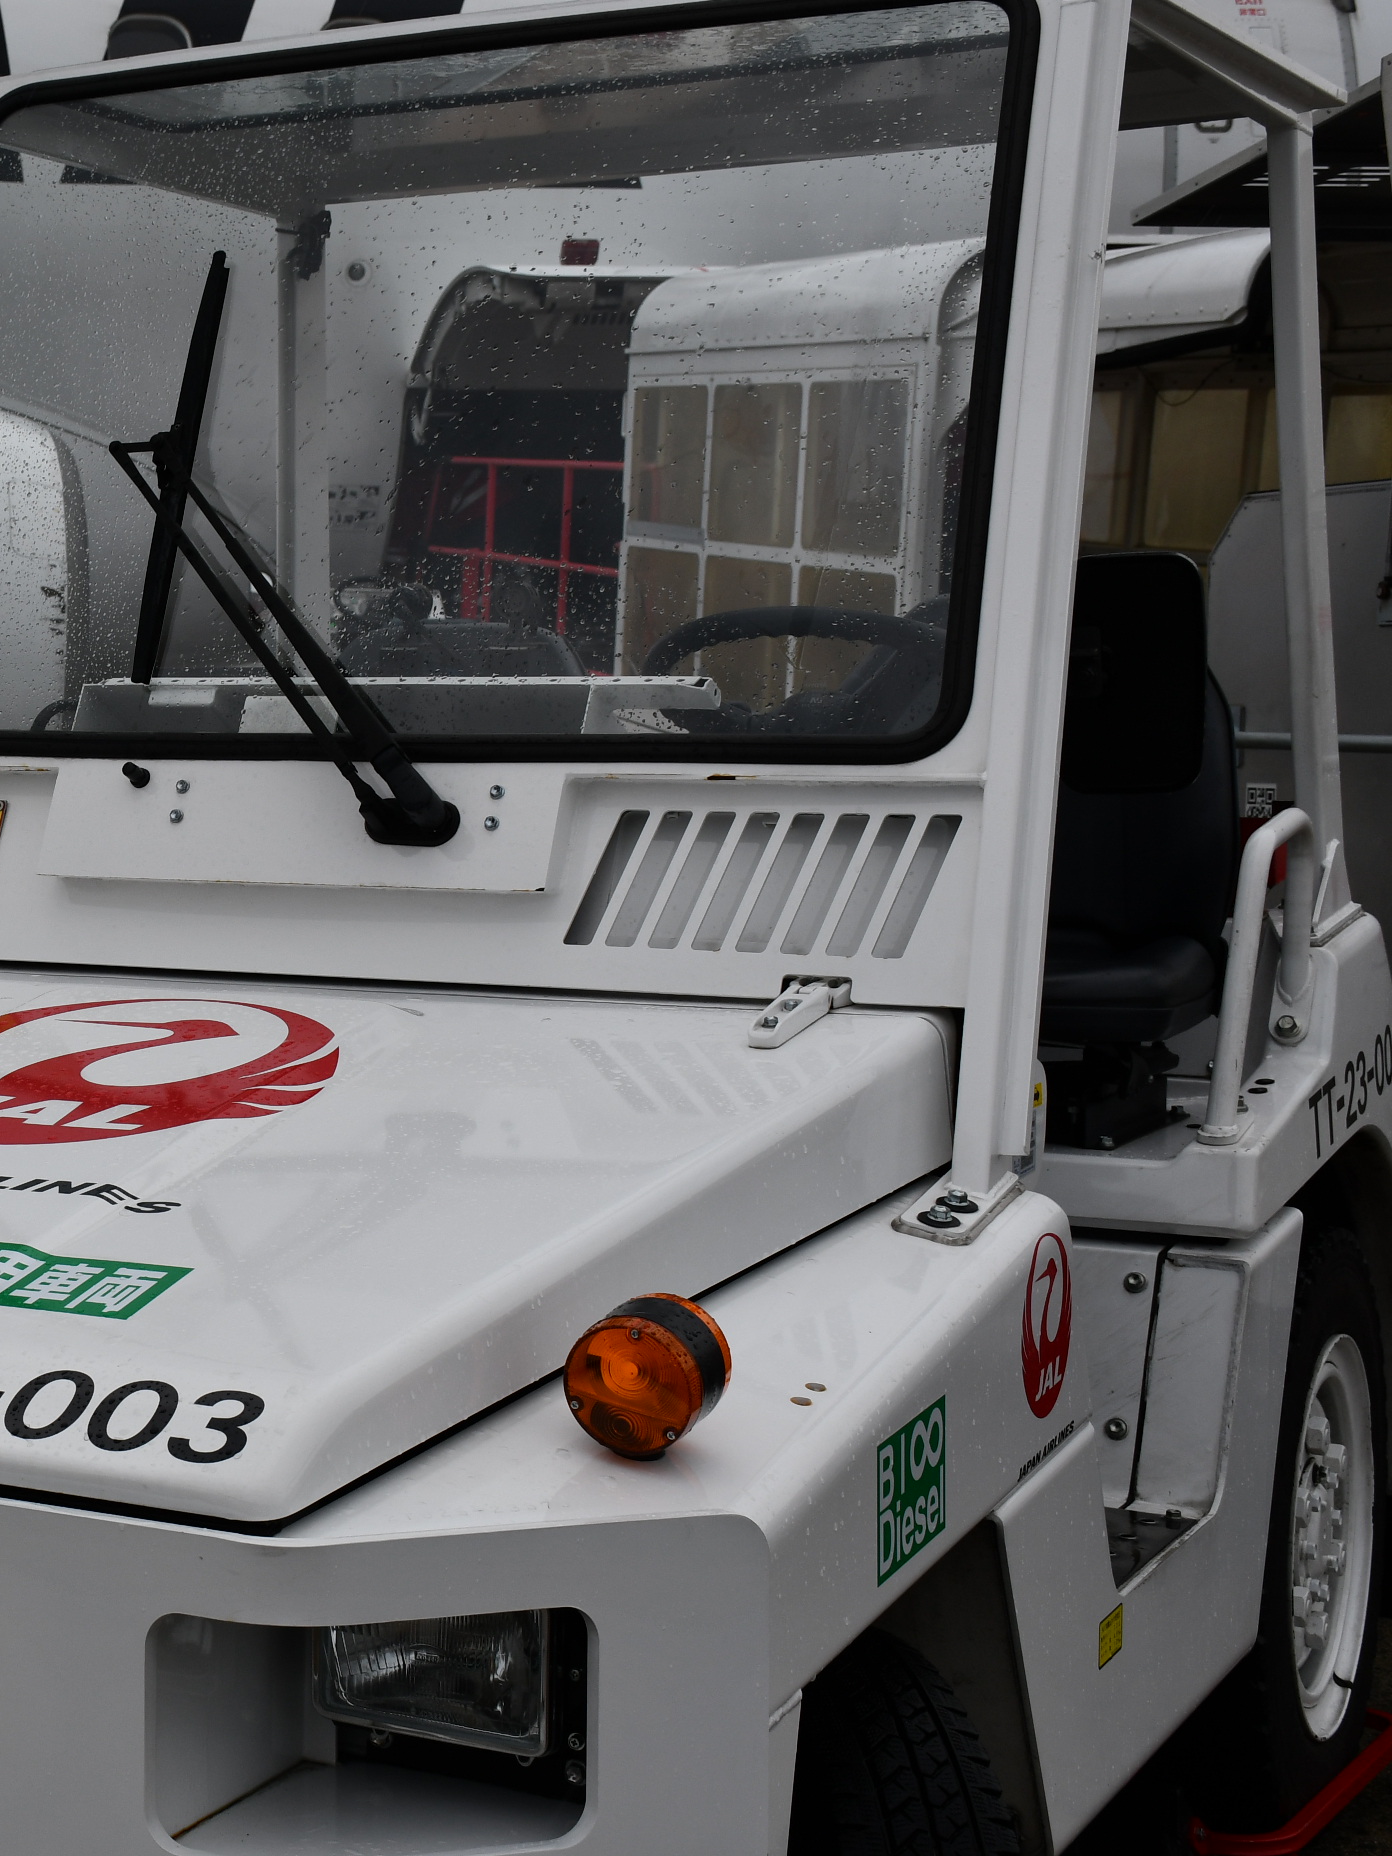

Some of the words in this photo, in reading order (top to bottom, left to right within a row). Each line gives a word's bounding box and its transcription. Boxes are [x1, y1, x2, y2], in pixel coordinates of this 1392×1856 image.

[1035, 1355, 1062, 1403] JAL
[1017, 1449, 1041, 1483] JAPAN
[1042, 1420, 1075, 1460] AIRLINES
[879, 1463, 945, 1577] Diesel
